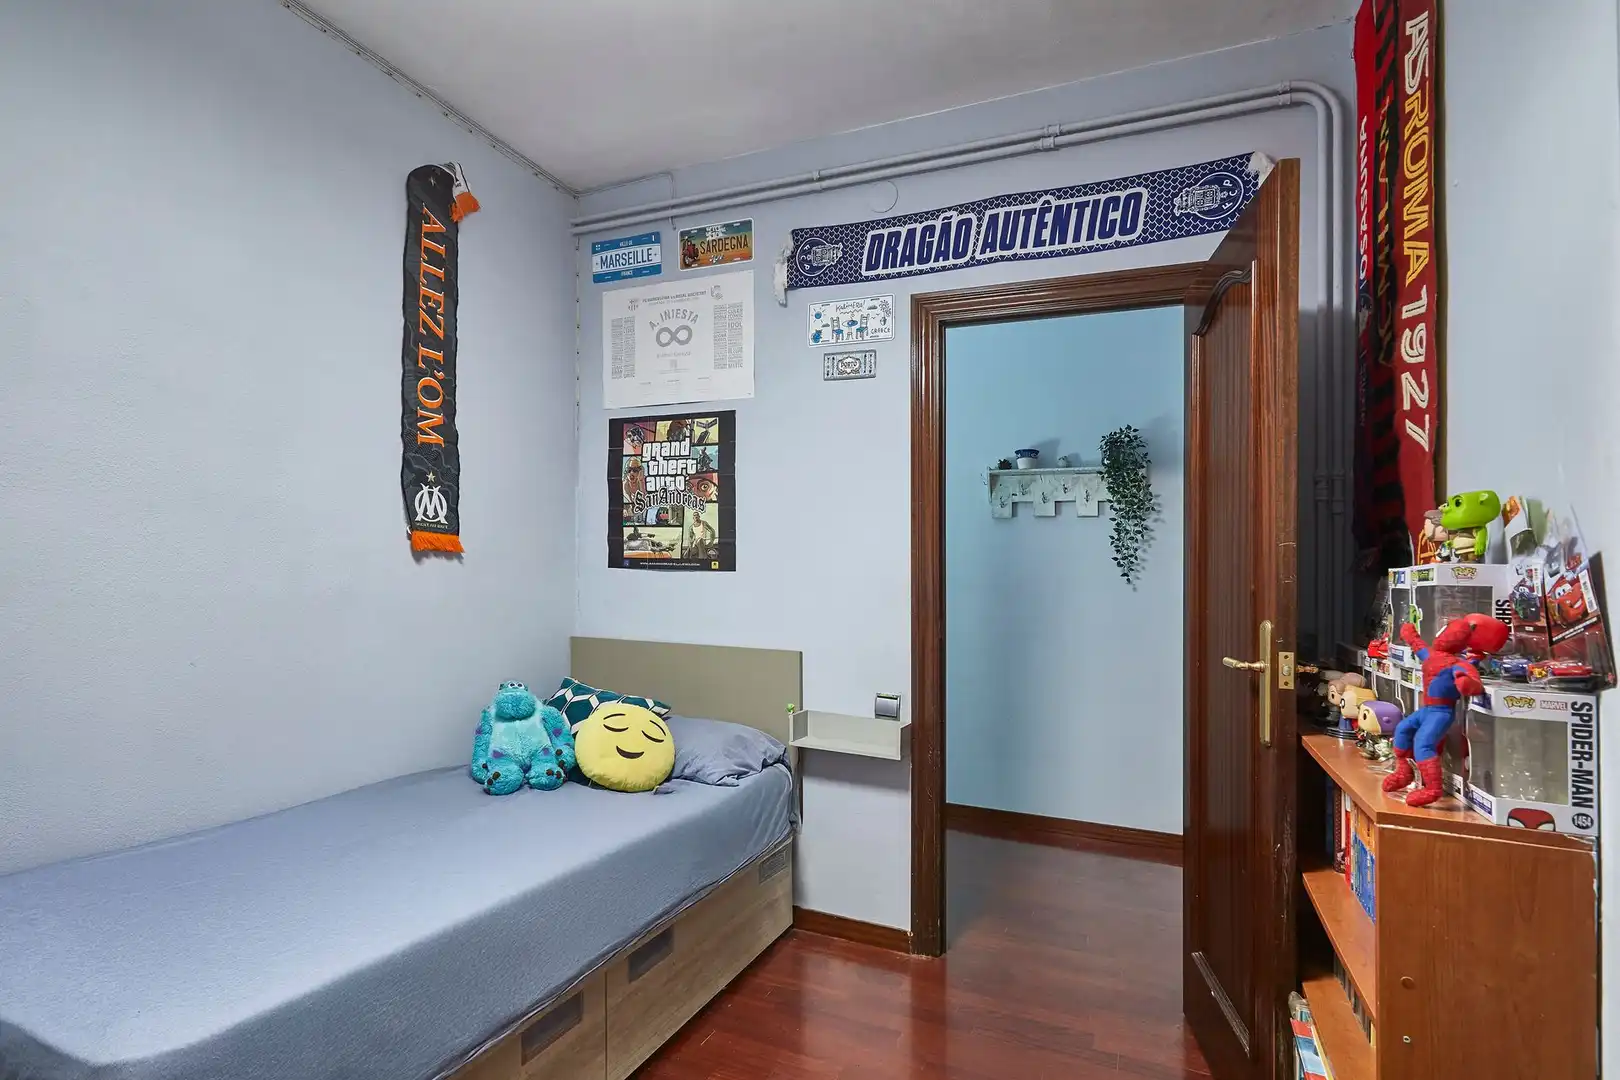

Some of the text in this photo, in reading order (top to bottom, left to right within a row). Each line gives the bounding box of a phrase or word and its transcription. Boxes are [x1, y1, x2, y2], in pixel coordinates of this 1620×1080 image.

[1359, 115, 1368, 281] OSASUNA
[699, 234, 750, 255] SARDEGNA
[864, 192, 1144, 272] DRAGÃO AUTÊNTICO
[600, 247, 653, 270] MARSEILLE
[416, 202, 447, 448] ALLEZ L'OM
[659, 308, 699, 324] INIESTA
[1400, 284, 1430, 452] 1927
[648, 459, 697, 476] theft
[1503, 695, 1568, 711] POP! MARVEL
[1570, 701, 1595, 809] SPIDER-MAN
